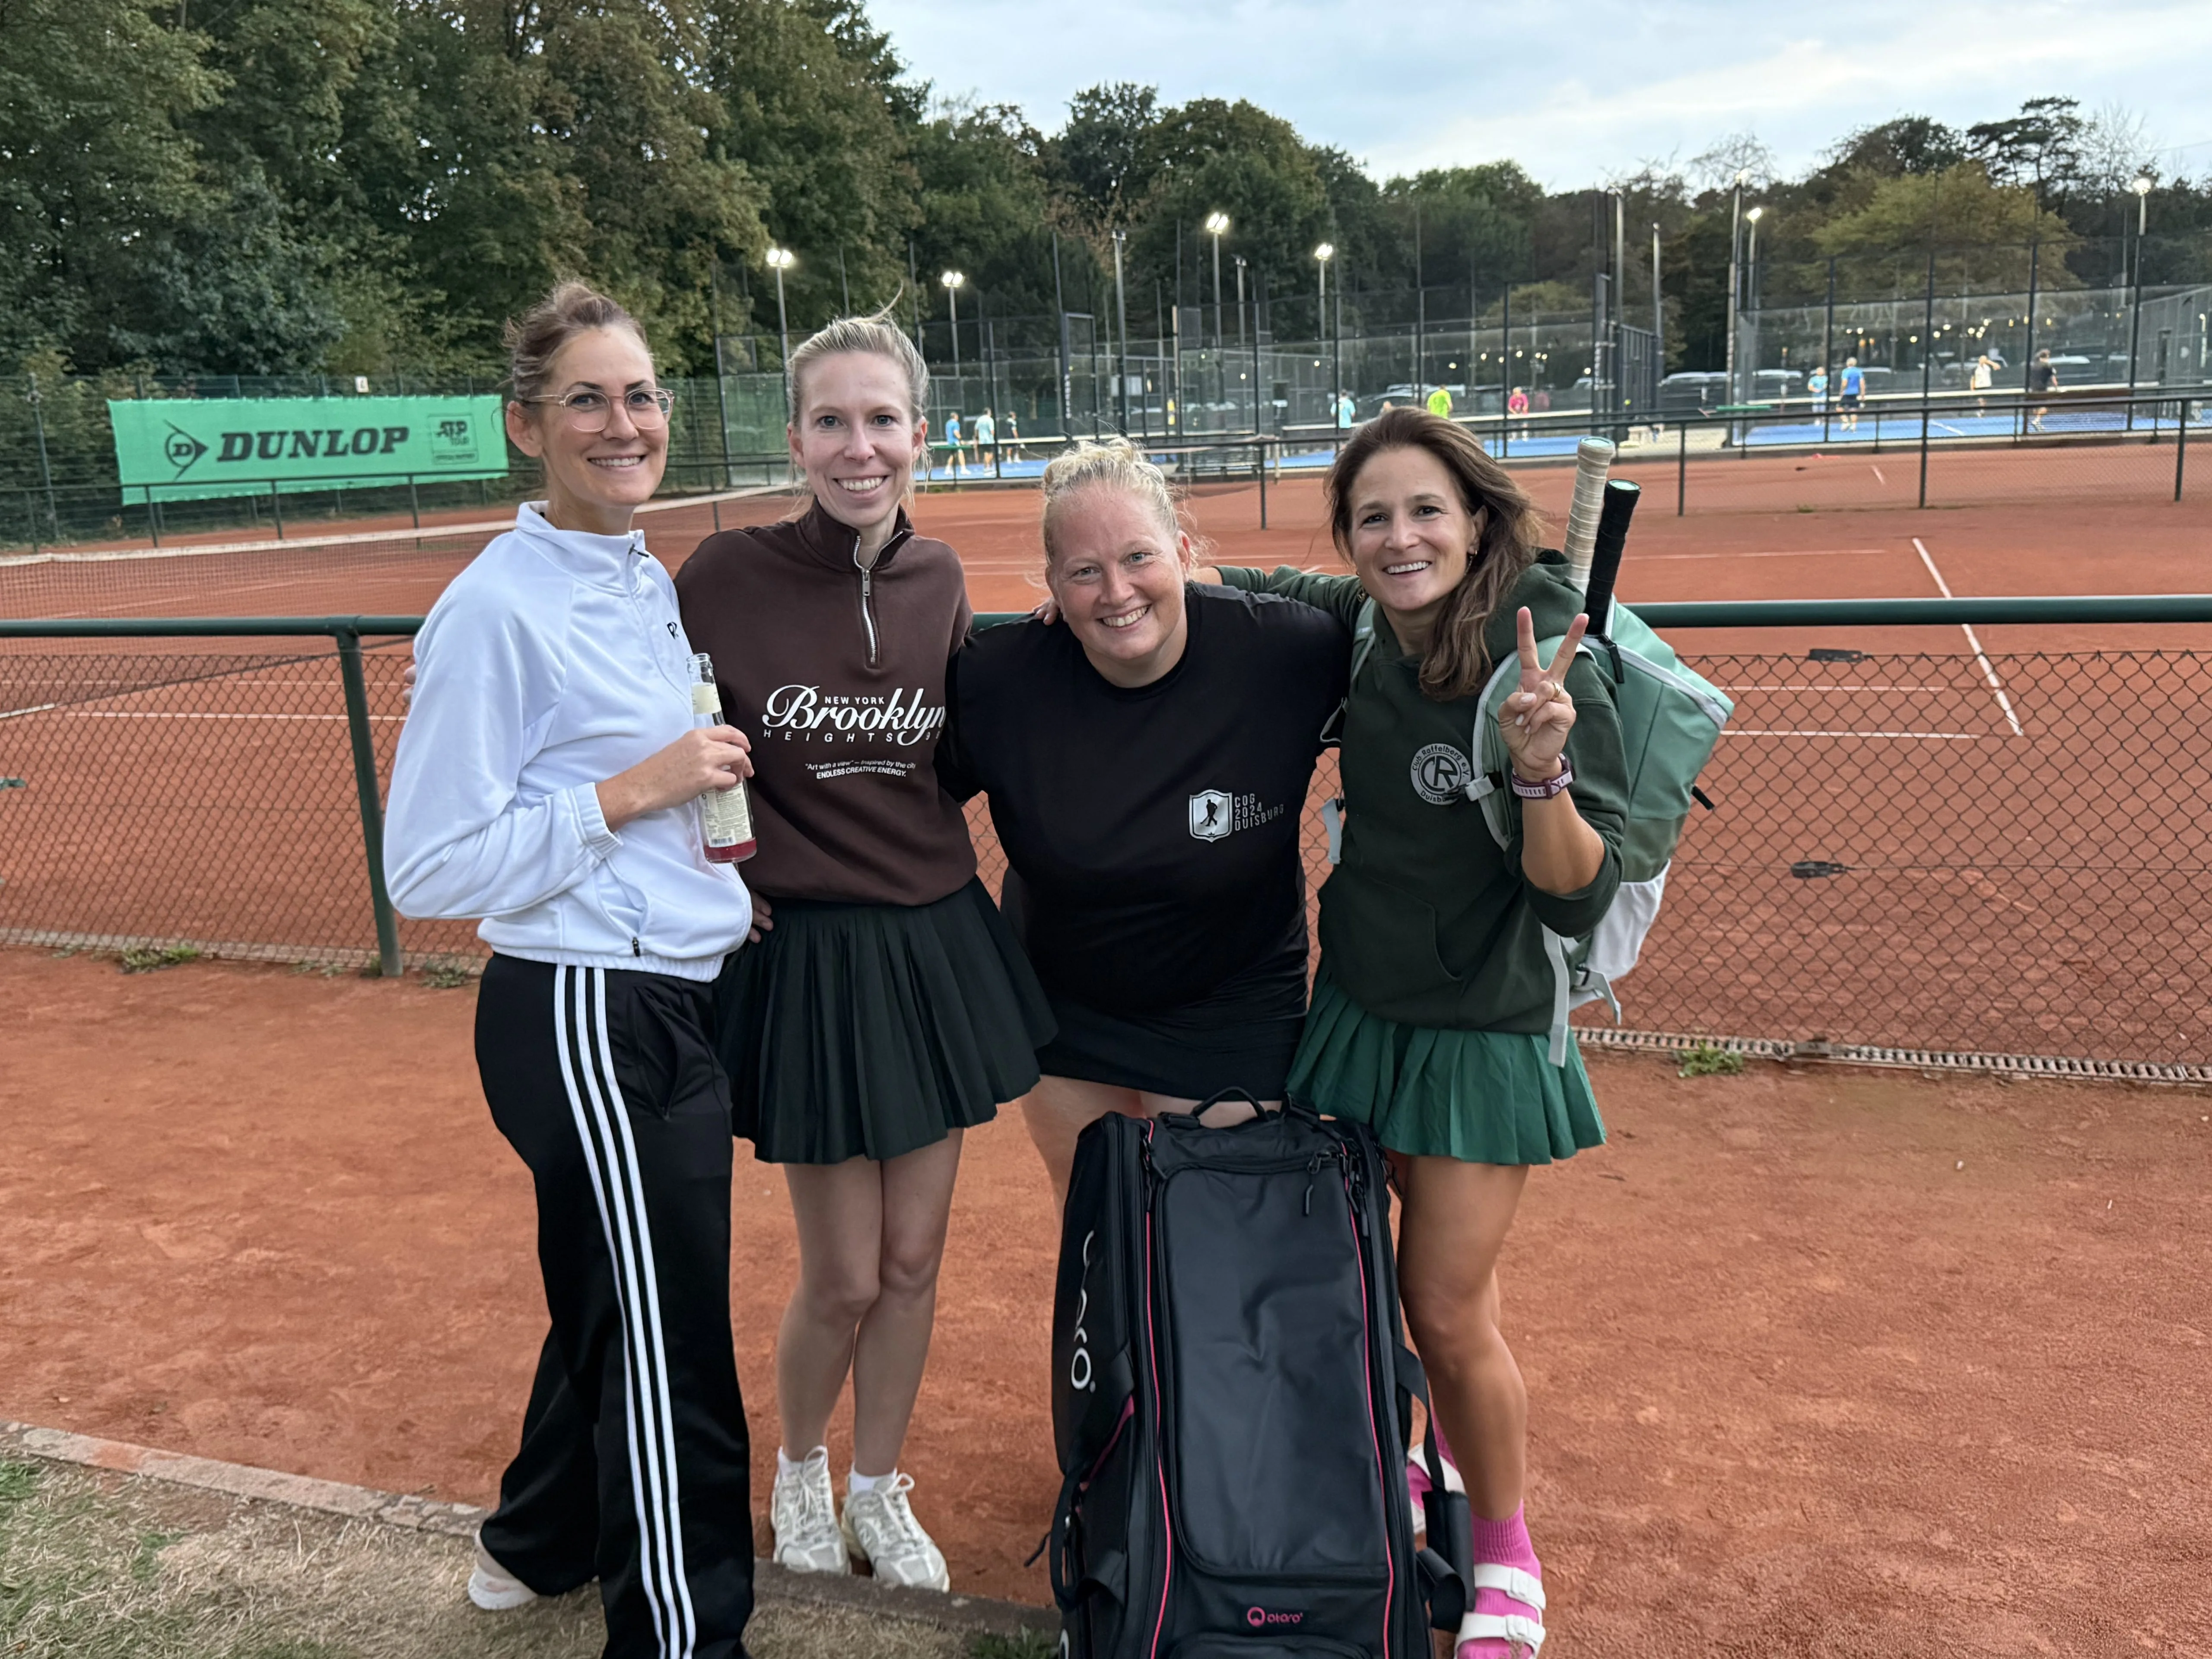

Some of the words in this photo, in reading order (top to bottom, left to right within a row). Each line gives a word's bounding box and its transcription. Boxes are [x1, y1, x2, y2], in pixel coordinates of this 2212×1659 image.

[217, 426, 410, 462] DUNLOP
[825, 696, 849, 705] NEW
[855, 696, 885, 705] YORK
[762, 684, 947, 746] Brooklyn
[763, 729, 893, 743] HEIGHTS
[1412, 756, 1421, 771] Club
[816, 768, 845, 779] ENDLESS
[877, 767, 906, 777] ENERGY.
[1234, 793, 1255, 808] COG
[1235, 801, 1262, 820] 2024
[1235, 804, 1284, 831] DUISBURG
